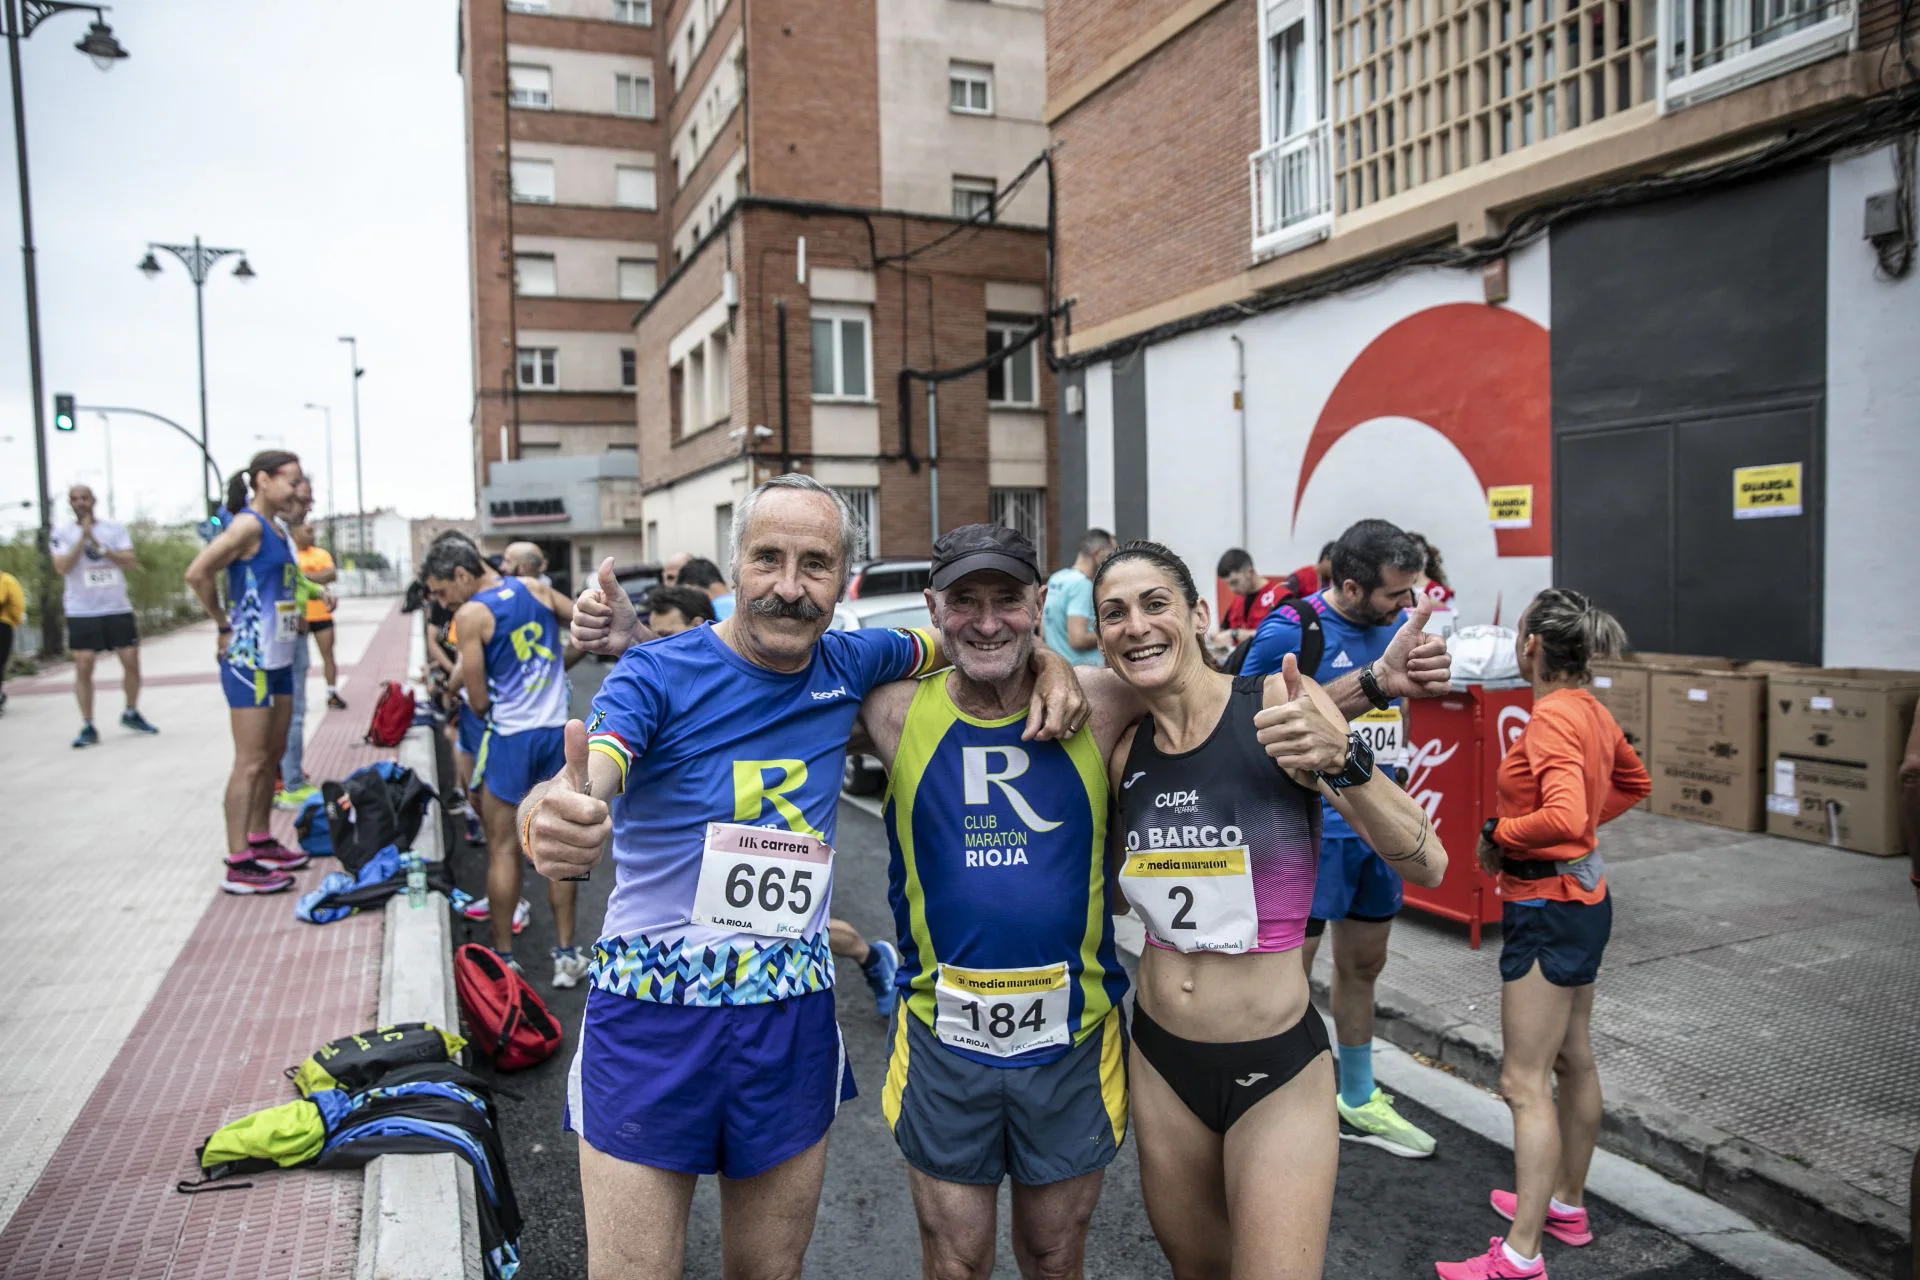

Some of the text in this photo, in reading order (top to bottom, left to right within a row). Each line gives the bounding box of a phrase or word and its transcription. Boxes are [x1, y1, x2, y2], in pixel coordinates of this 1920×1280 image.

[1742, 479, 1792, 491] GUARDA
[1751, 493, 1784, 503] ROPA
[962, 745, 1064, 832] R
[1155, 789, 1199, 808] CUPA
[964, 815, 997, 829] CLUB
[965, 828, 1027, 847] MARATÓN
[1148, 825, 1243, 848] BARCO
[760, 840, 809, 855] carrera
[965, 848, 1029, 867] RIOJA
[1147, 859, 1180, 870] media
[725, 863, 812, 915] 665
[1168, 885, 1197, 930] 2
[713, 916, 752, 929] LA RIOJA
[968, 978, 1005, 989] media
[961, 998, 1047, 1039] 184
[954, 1034, 990, 1050] LA RIOJA
